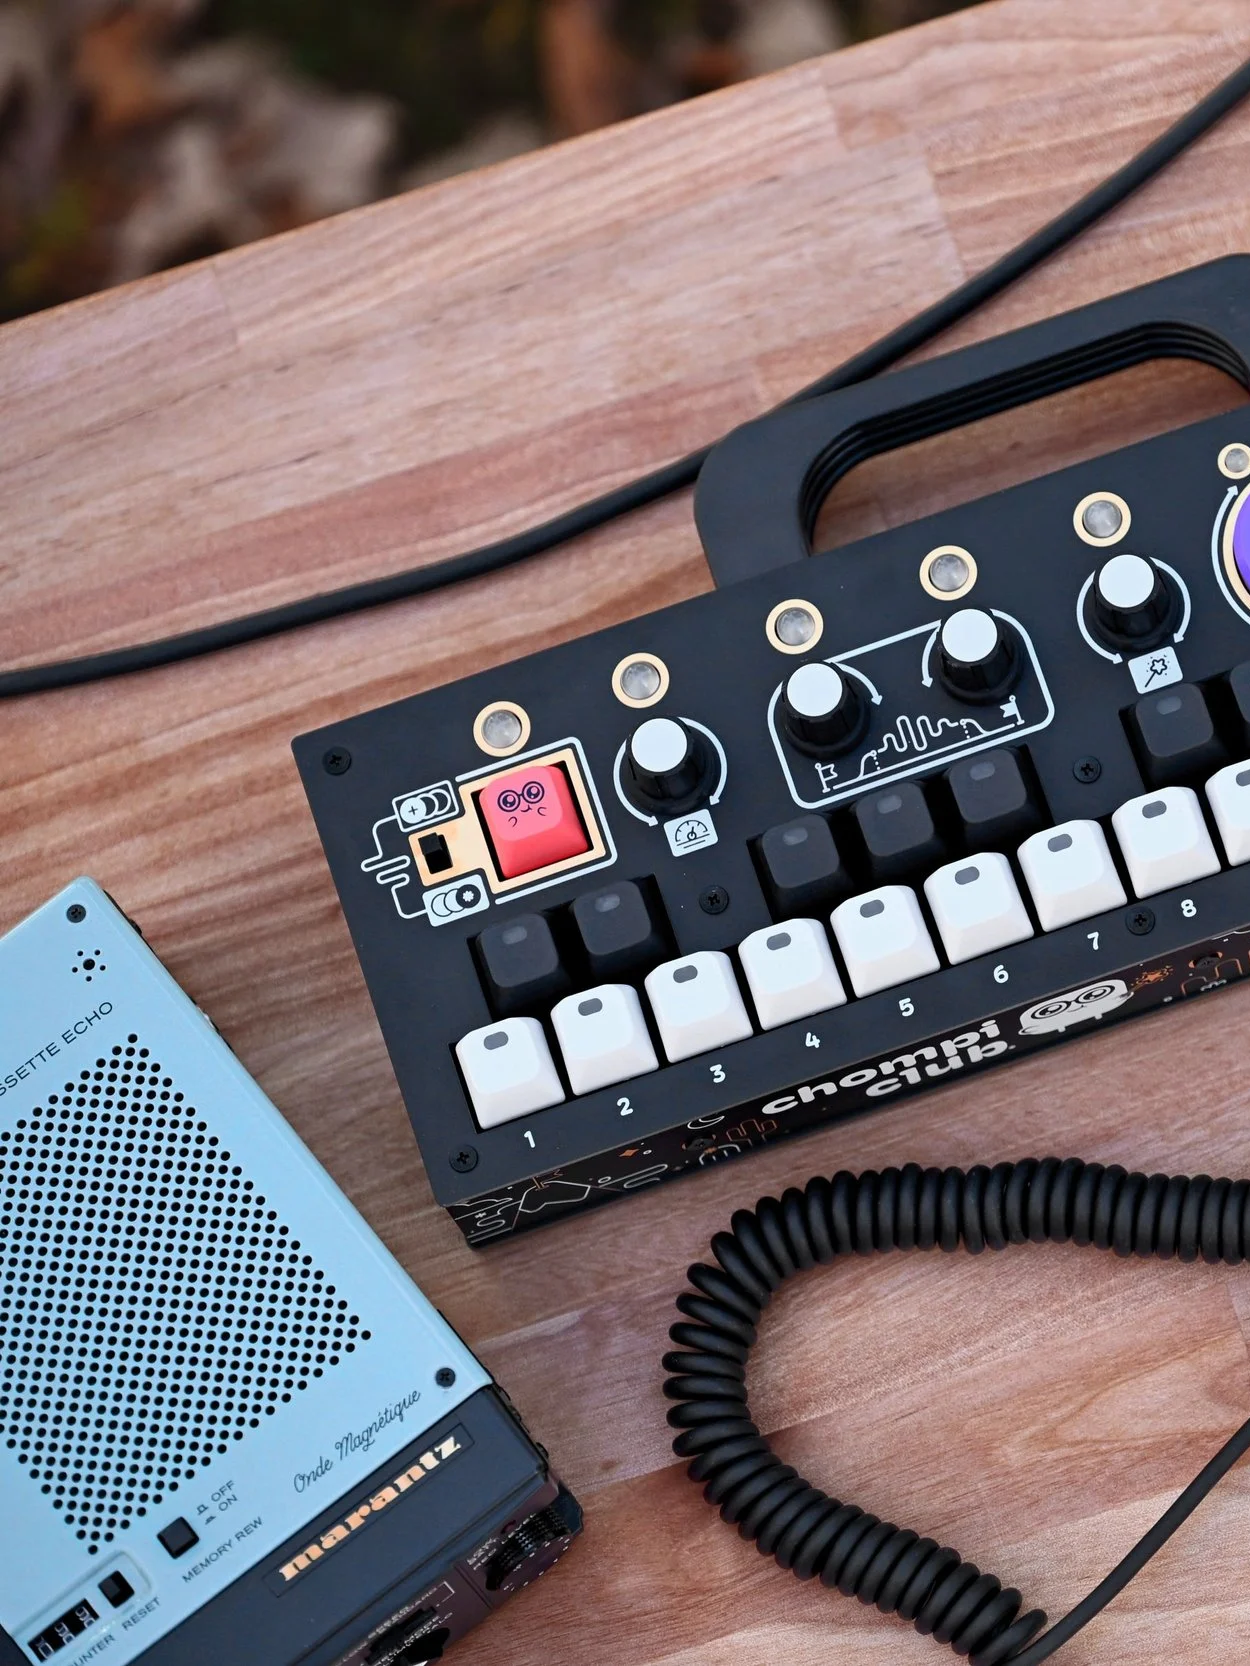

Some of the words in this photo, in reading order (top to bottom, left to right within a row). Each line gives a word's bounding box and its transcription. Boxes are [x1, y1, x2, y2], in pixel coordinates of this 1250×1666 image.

[1180, 898, 1197, 918] 8
[1086, 931, 1100, 951] 7
[993, 964, 1009, 984] 6
[898, 997, 915, 1017] 5
[61, 1002, 113, 1044] ECHO
[805, 1031, 821, 1049] 4
[709, 1063, 726, 1084] 3
[762, 1020, 1000, 1114] chompi
[616, 1096, 634, 1117] 2
[523, 1130, 536, 1149] 1
[293, 1456, 333, 1493] Onde
[335, 1390, 421, 1461] Magnétique
[211, 1480, 235, 1502] OFF
[218, 1494, 238, 1512] ON
[279, 1436, 462, 1582] marantz
[182, 1539, 233, 1583] MEMORY
[234, 1516, 263, 1541] REW
[122, 1597, 161, 1631] RESET
[70, 1634, 115, 1666] UNTER
